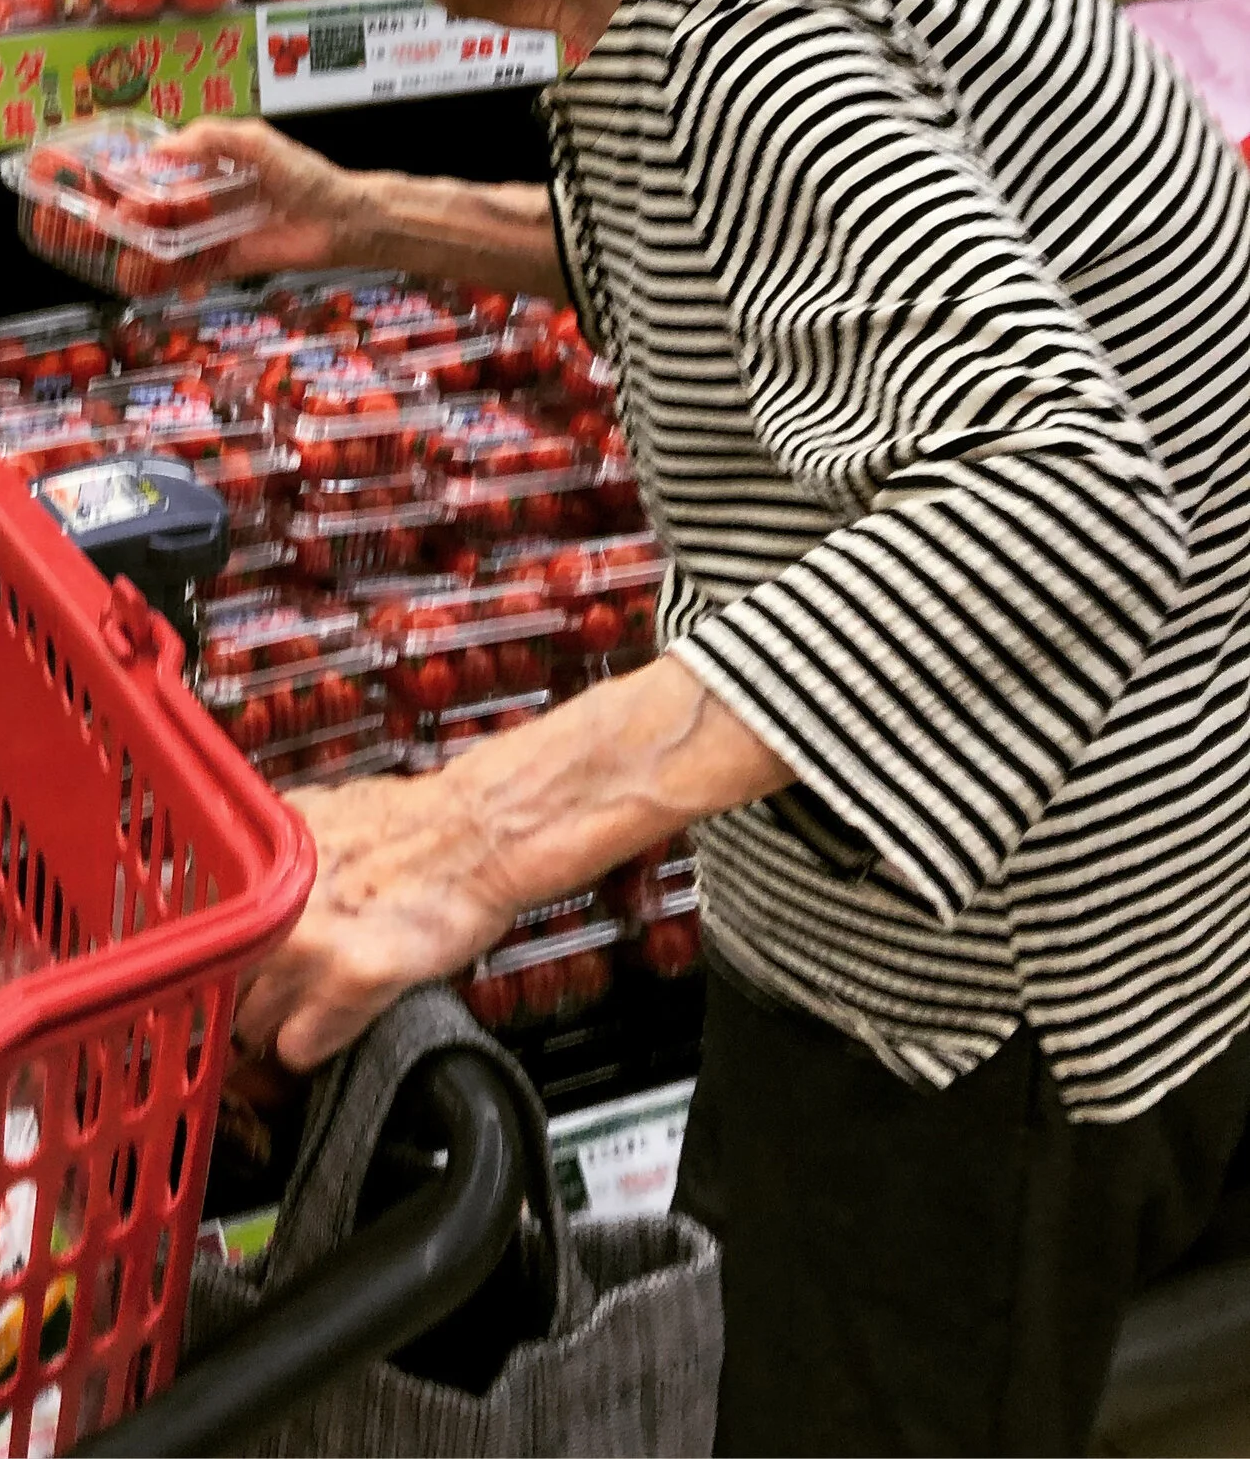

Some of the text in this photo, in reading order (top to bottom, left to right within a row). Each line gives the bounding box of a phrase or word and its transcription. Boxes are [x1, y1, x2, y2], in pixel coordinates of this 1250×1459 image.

[130, 23, 243, 78] サラダ
[150, 74, 235, 120] 特集
